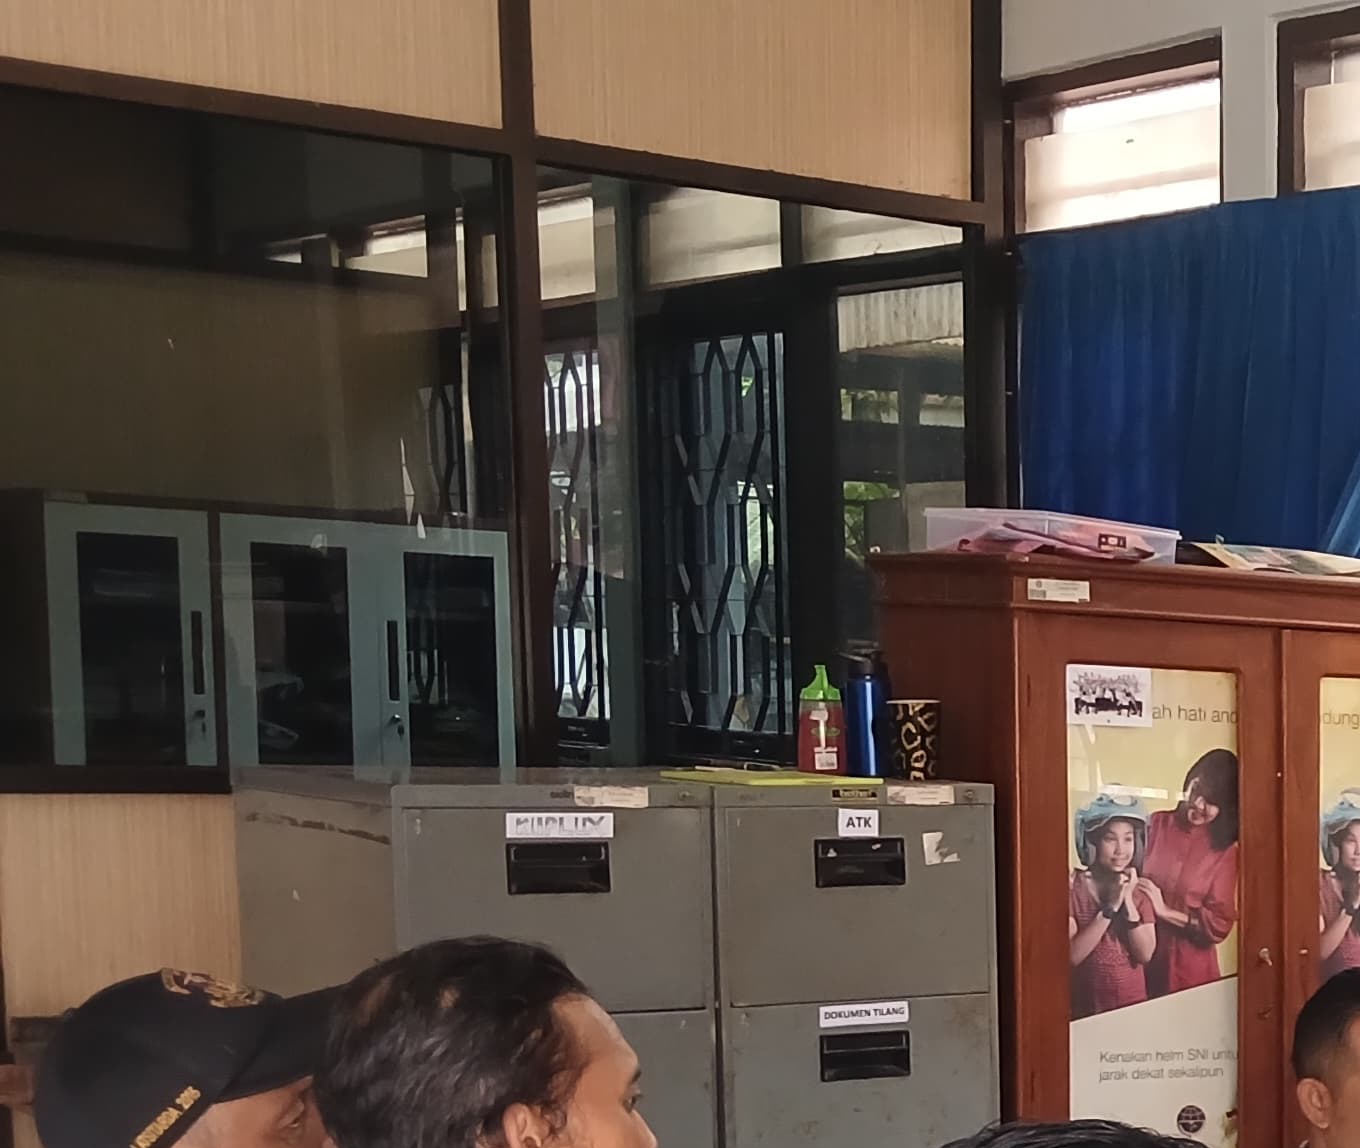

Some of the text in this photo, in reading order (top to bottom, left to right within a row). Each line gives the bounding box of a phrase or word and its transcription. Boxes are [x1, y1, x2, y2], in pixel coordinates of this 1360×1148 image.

[1177, 704, 1207, 721] hati
[846, 816, 872, 828] ATK
[824, 1006, 905, 1020] DOKUMEN TILANG
[1100, 1050, 1152, 1063] Kenakan
[1156, 1049, 1184, 1062] helm
[1187, 1048, 1208, 1061] SNI
[1099, 1066, 1224, 1083] jarak dekat sekalipun
